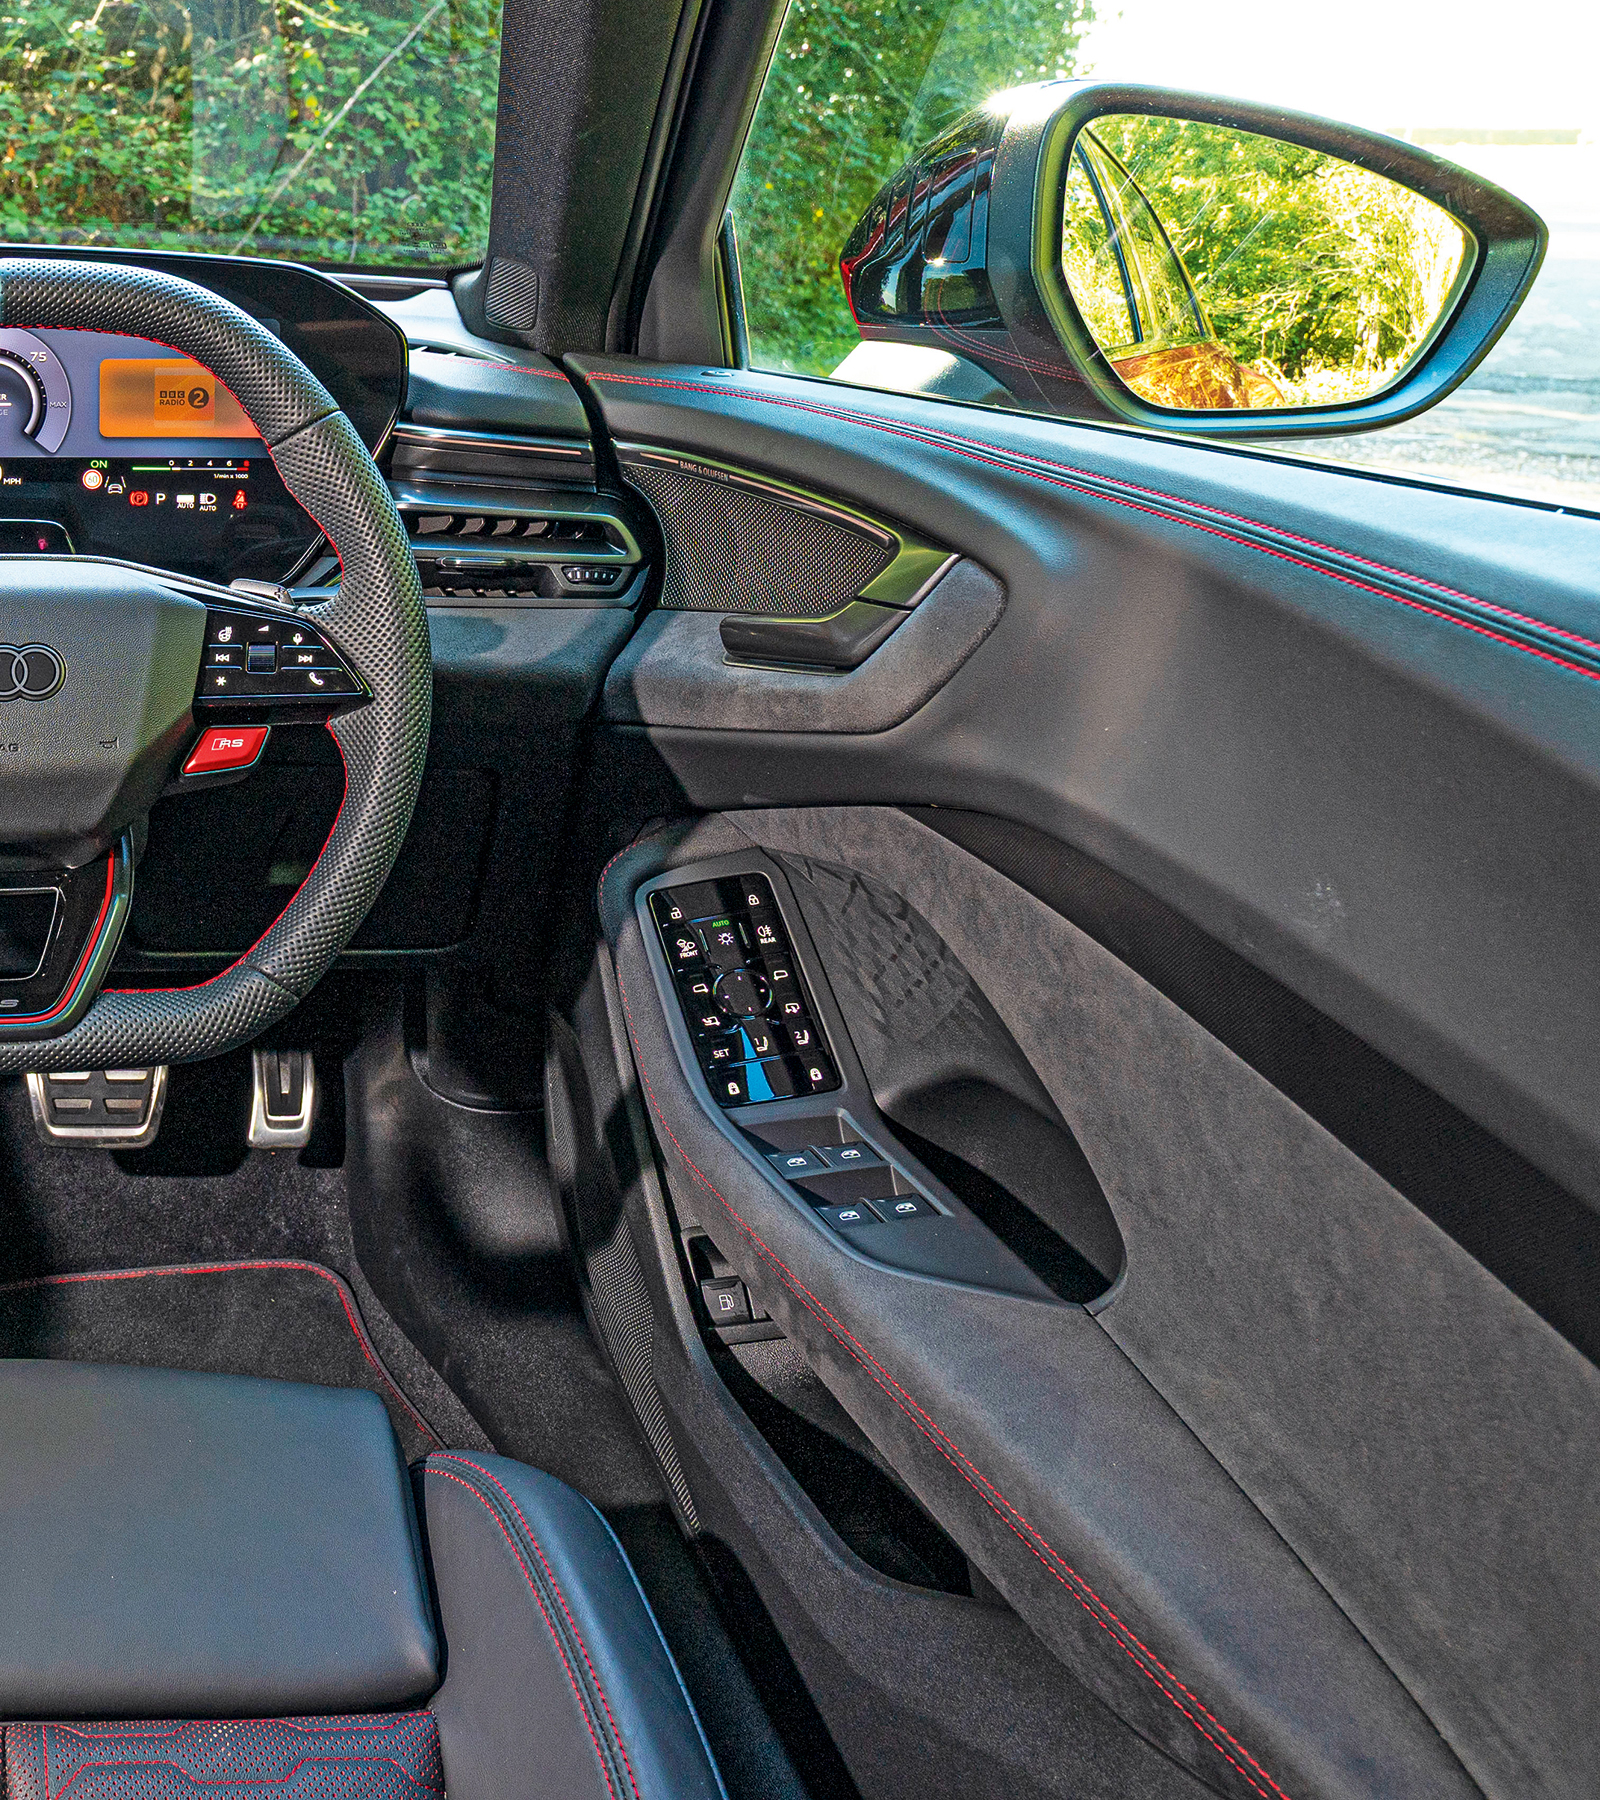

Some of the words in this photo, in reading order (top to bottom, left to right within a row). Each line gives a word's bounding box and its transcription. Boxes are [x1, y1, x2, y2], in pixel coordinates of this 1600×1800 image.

[30, 352, 47, 362] 75
[91, 460, 108, 468] ON
[680, 460, 697, 472] BANG
[703, 468, 728, 481] OLUFSEN
[3, 477, 22, 485] MPH
[156, 493, 166, 504] P
[712, 920, 730, 928] AUTO
[680, 950, 698, 958] FRONT
[794, 1032, 802, 1040] 2
[713, 1049, 730, 1058] SET
